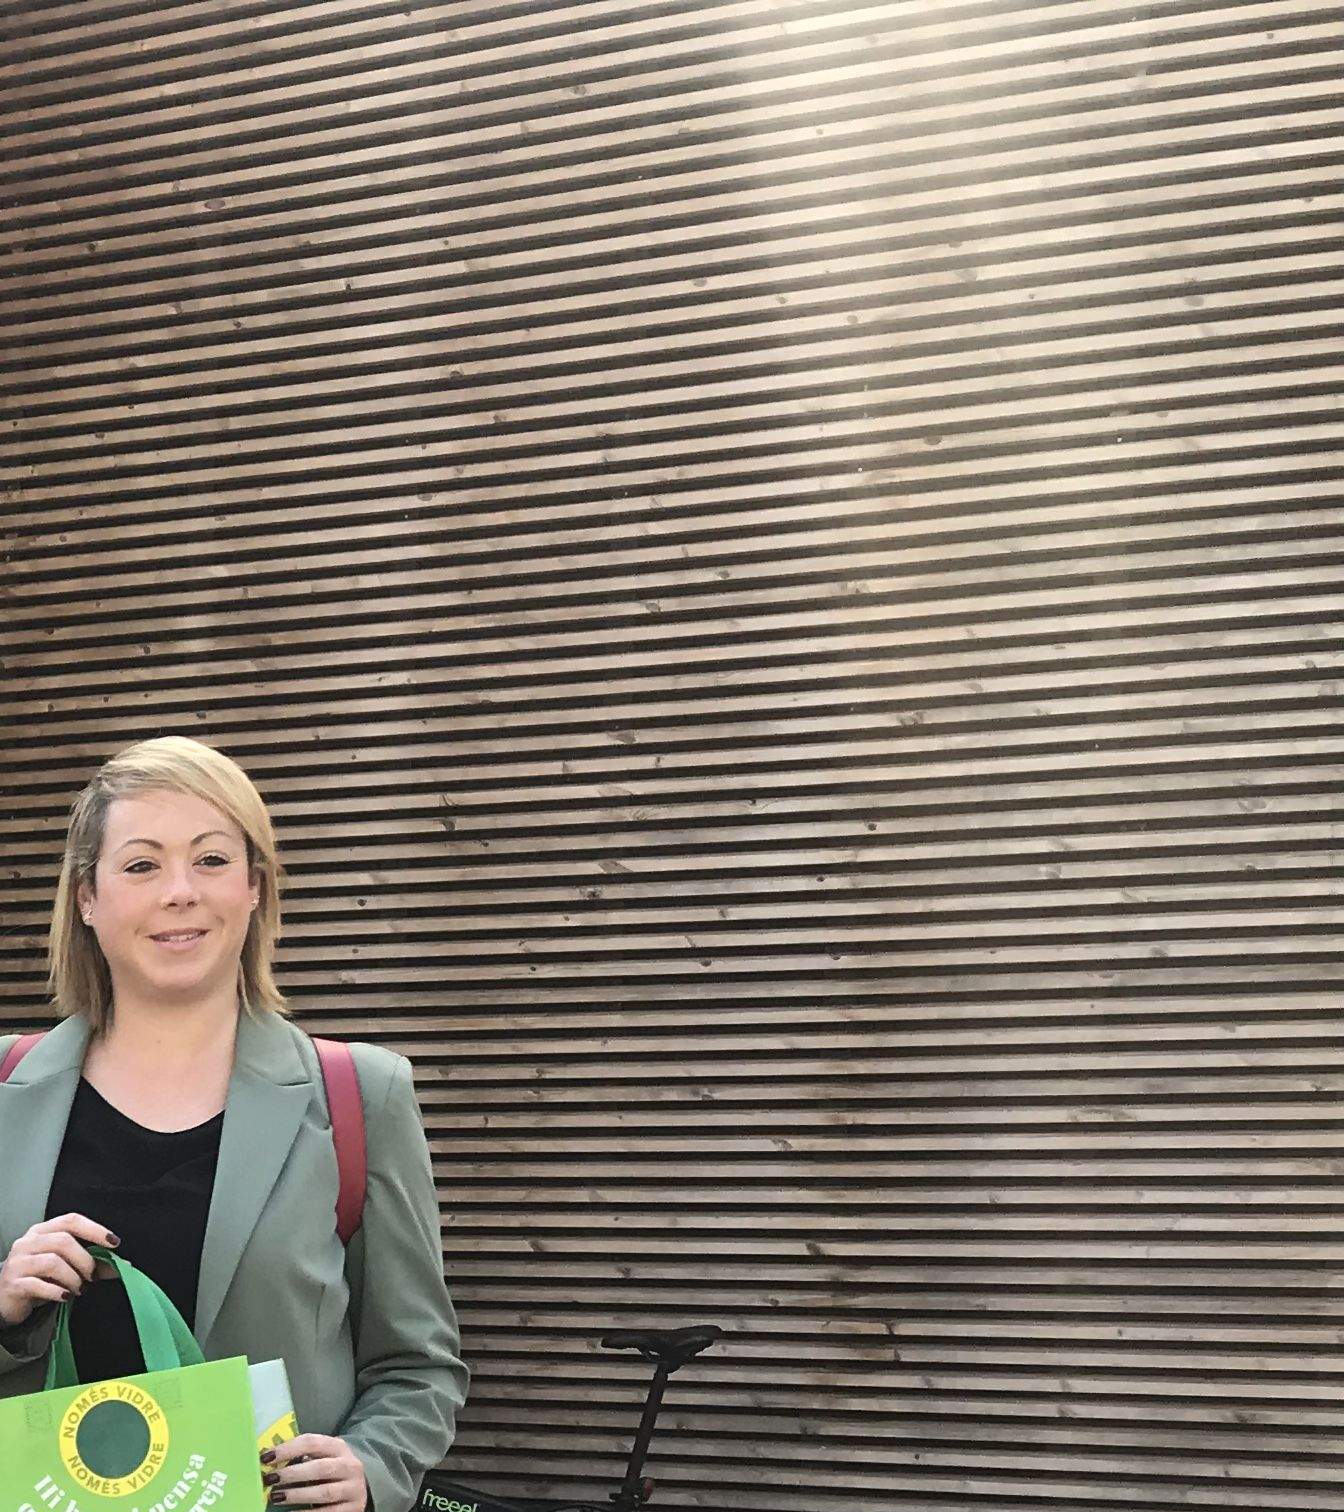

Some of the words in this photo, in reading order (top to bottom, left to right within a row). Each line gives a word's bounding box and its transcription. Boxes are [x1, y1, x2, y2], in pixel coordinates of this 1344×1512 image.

[63, 1386, 108, 1438] NOMÉS
[117, 1386, 160, 1423] VIDRE
[127, 1443, 165, 1489] VIDRE
